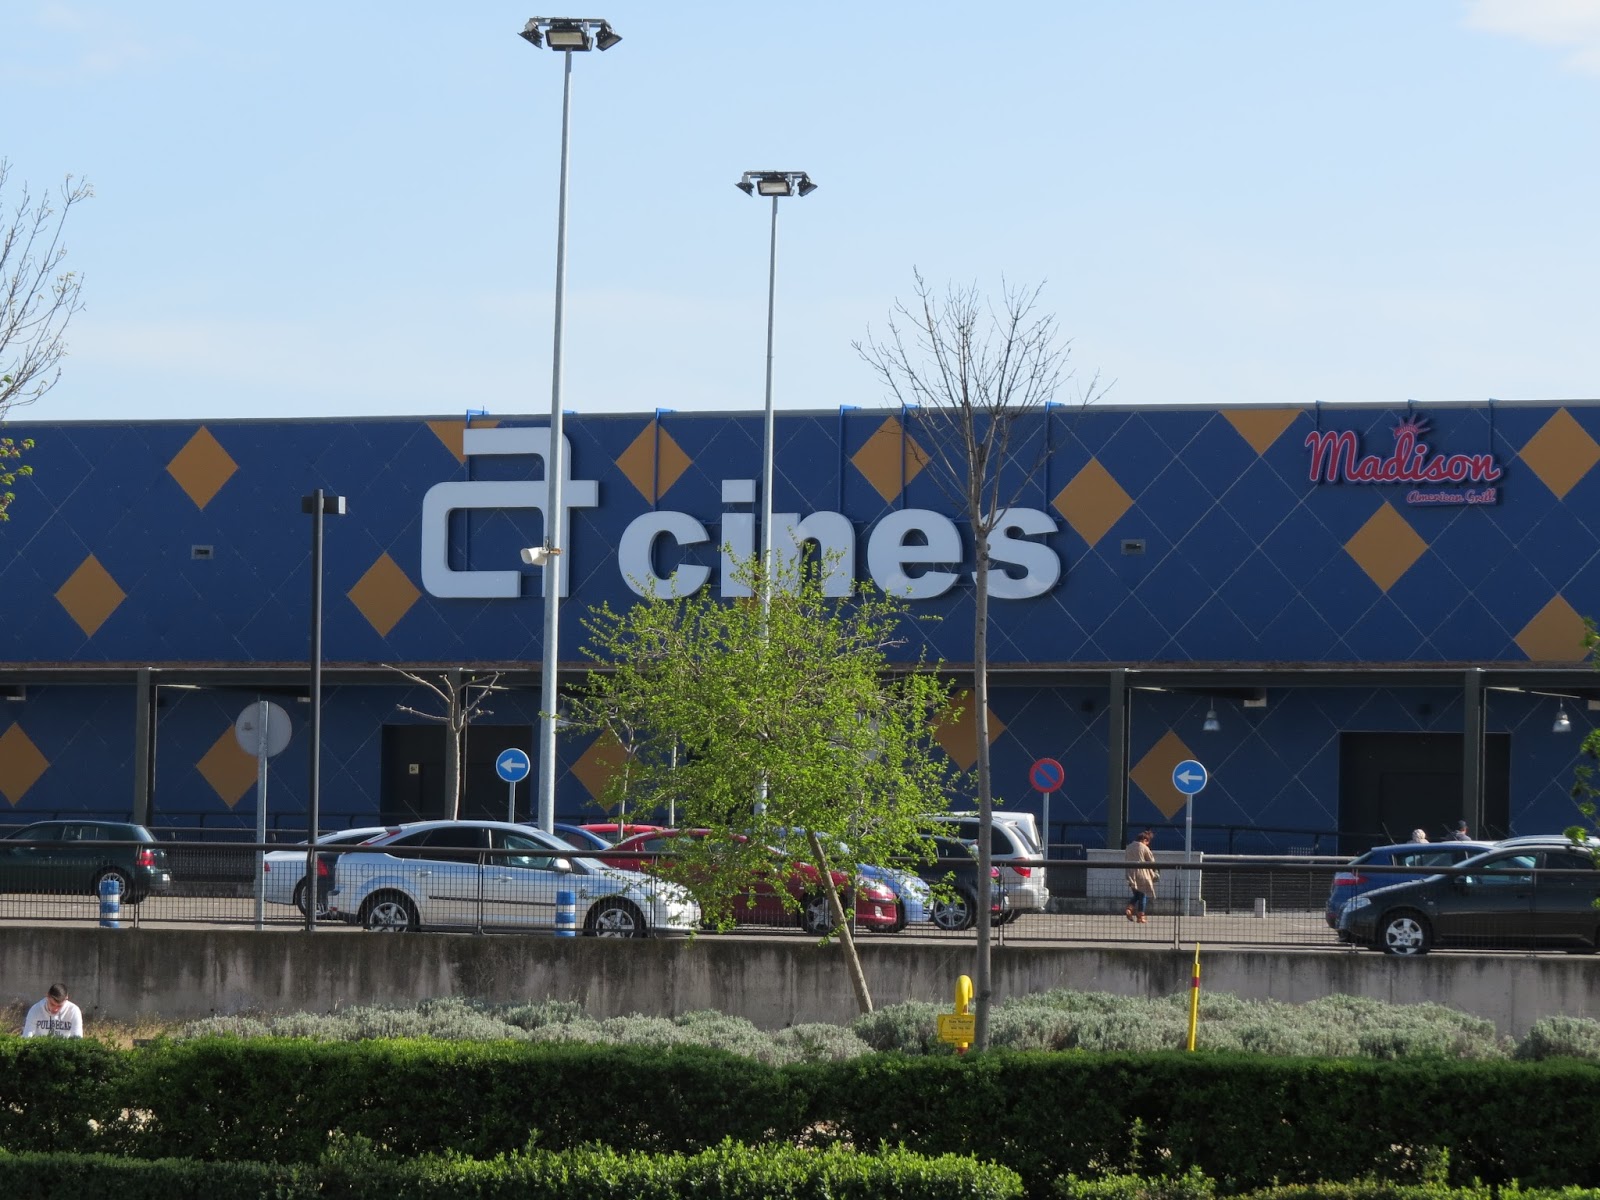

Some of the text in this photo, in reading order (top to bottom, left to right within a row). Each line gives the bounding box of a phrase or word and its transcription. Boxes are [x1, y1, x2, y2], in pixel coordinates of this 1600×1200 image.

[1305, 431, 1501, 482] Madison
[1406, 488, 1496, 503] American Grill
[618, 479, 1060, 599] cines
